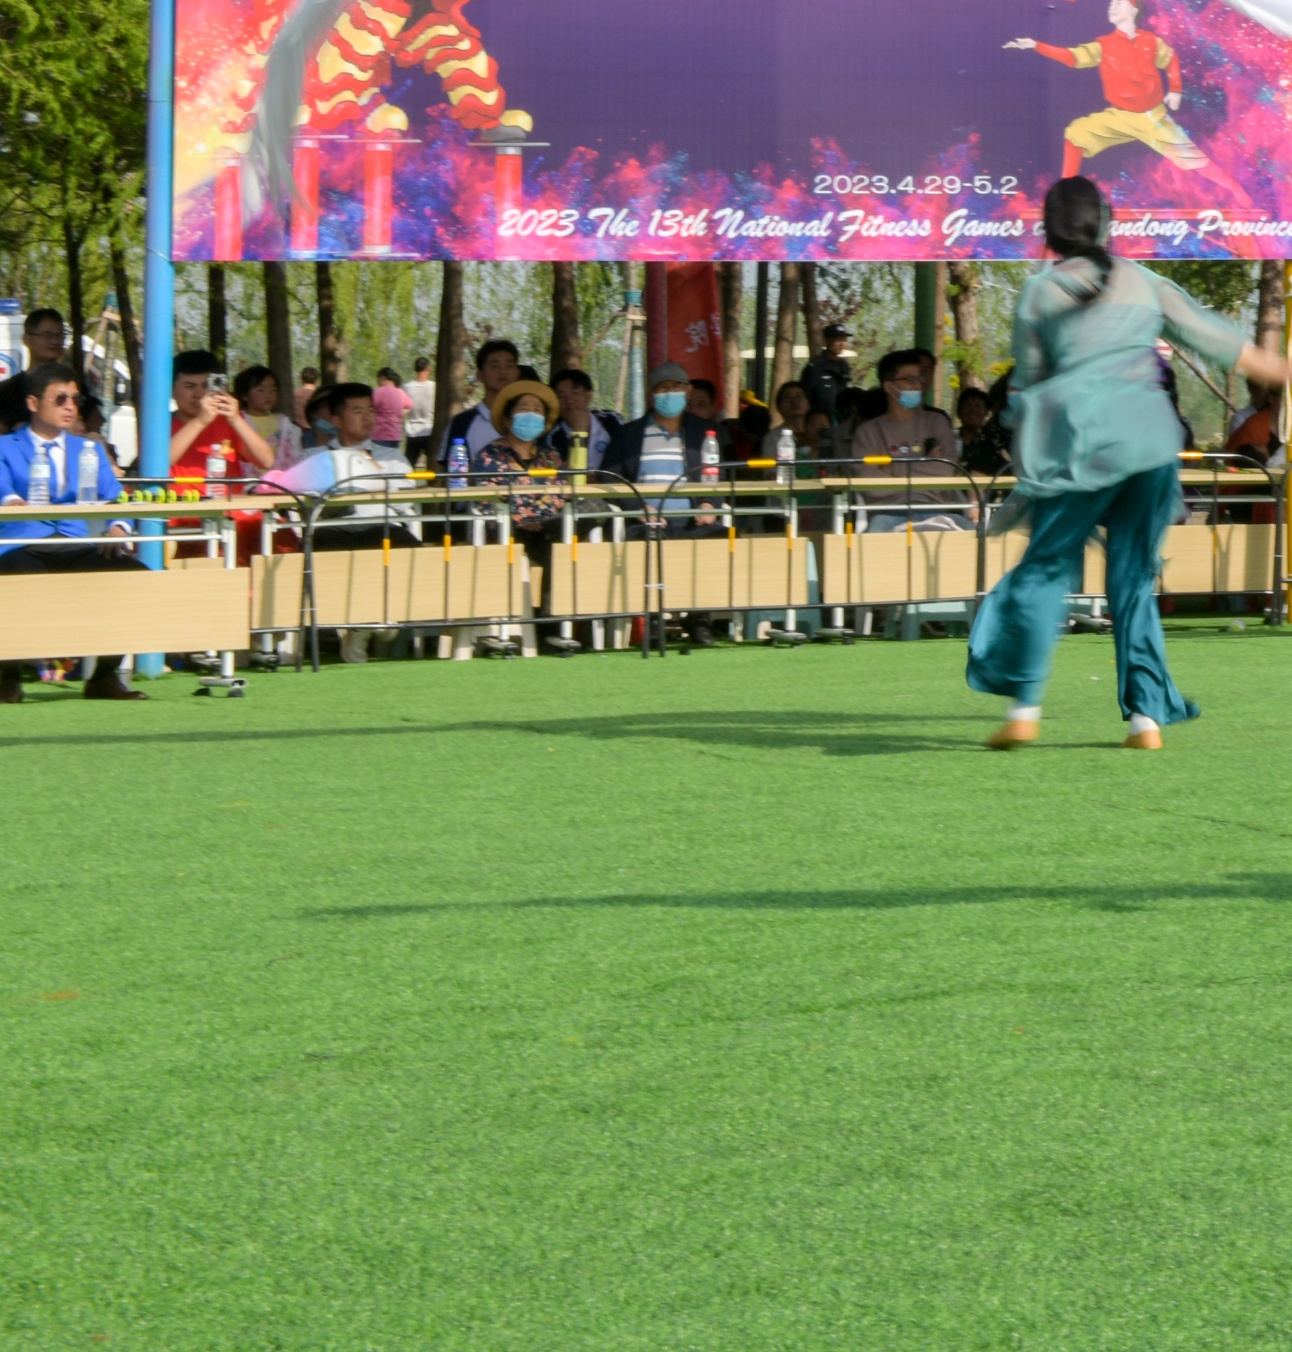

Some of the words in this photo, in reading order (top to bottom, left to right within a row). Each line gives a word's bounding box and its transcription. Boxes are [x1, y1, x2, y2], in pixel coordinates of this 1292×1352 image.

[813, 174, 1018, 196] 2023.4.29-5.2
[497, 207, 580, 238] 2023
[588, 207, 640, 238] The
[647, 208, 710, 238] 13th
[712, 208, 833, 238] National
[837, 209, 932, 243] Fitness
[942, 208, 1025, 246] Games
[1109, 212, 1189, 246] andong
